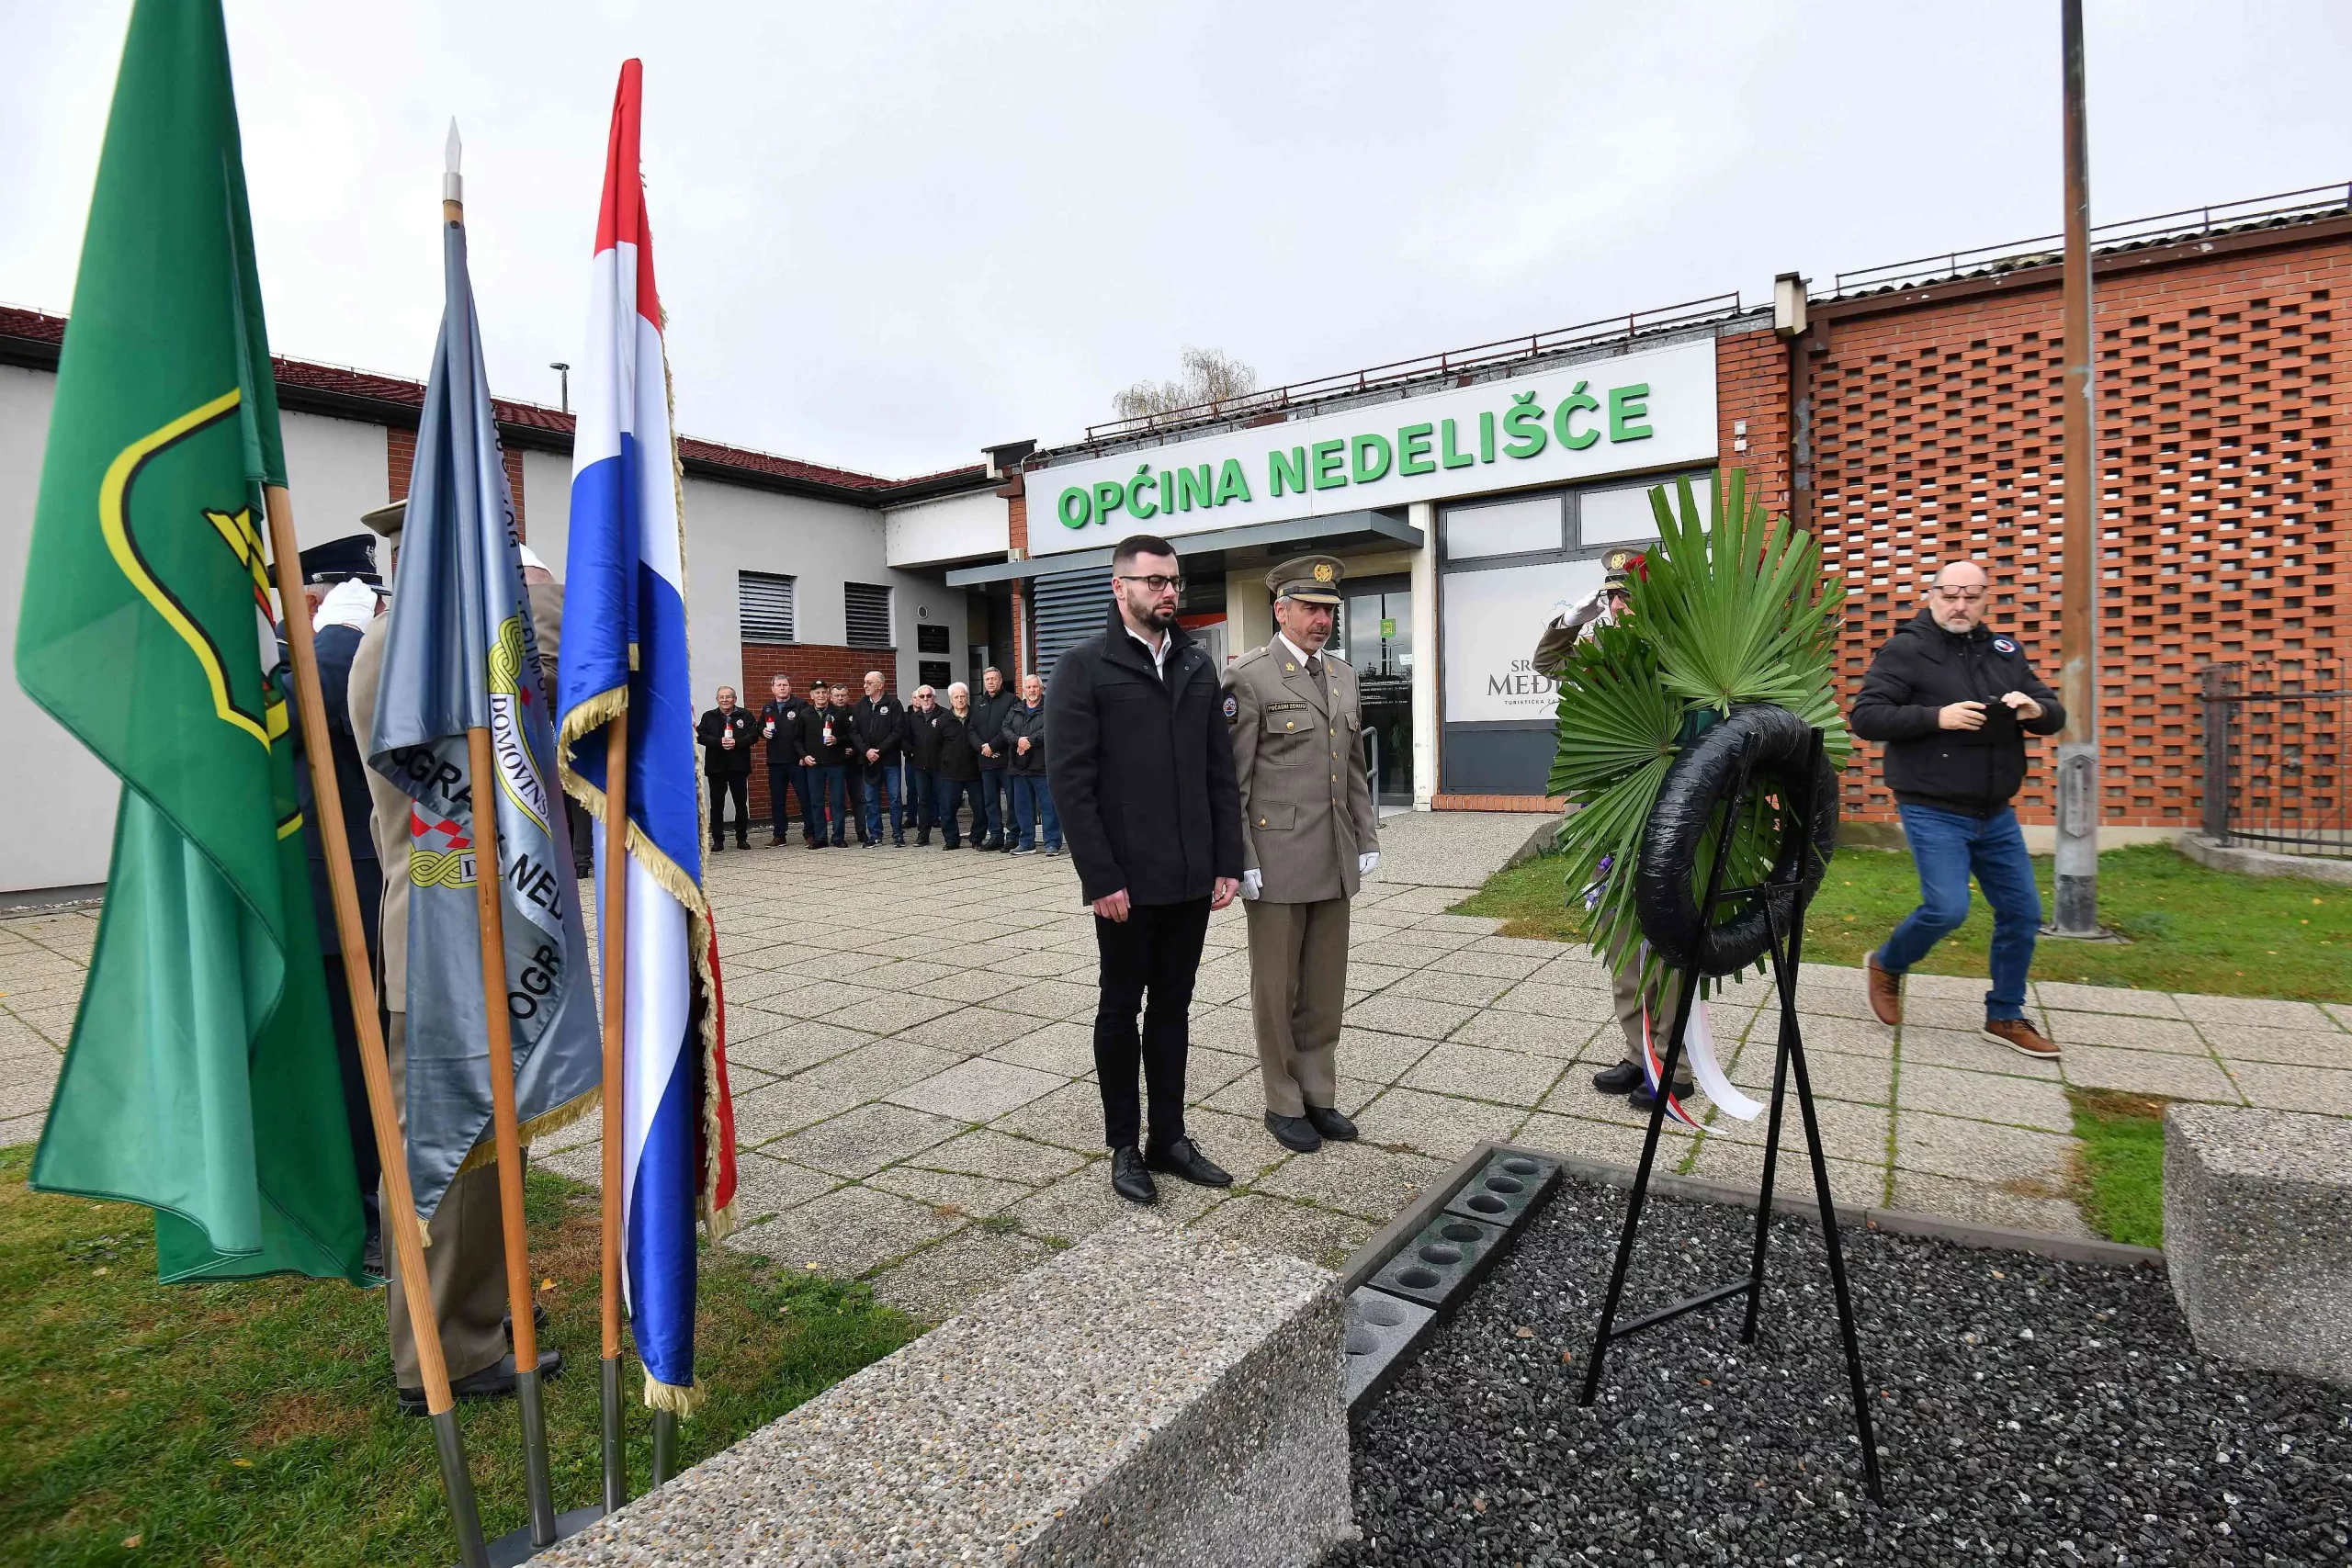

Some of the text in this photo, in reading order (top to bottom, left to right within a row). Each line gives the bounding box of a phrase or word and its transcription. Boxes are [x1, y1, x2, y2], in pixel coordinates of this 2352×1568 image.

[1057, 380, 1654, 530] OPĆINA NEDELIŠĆE
[1510, 660, 1532, 671] SR
[492, 697, 550, 821] DOMOVINS
[390, 747, 563, 921] OGRA NED
[507, 943, 561, 1020] OGR
